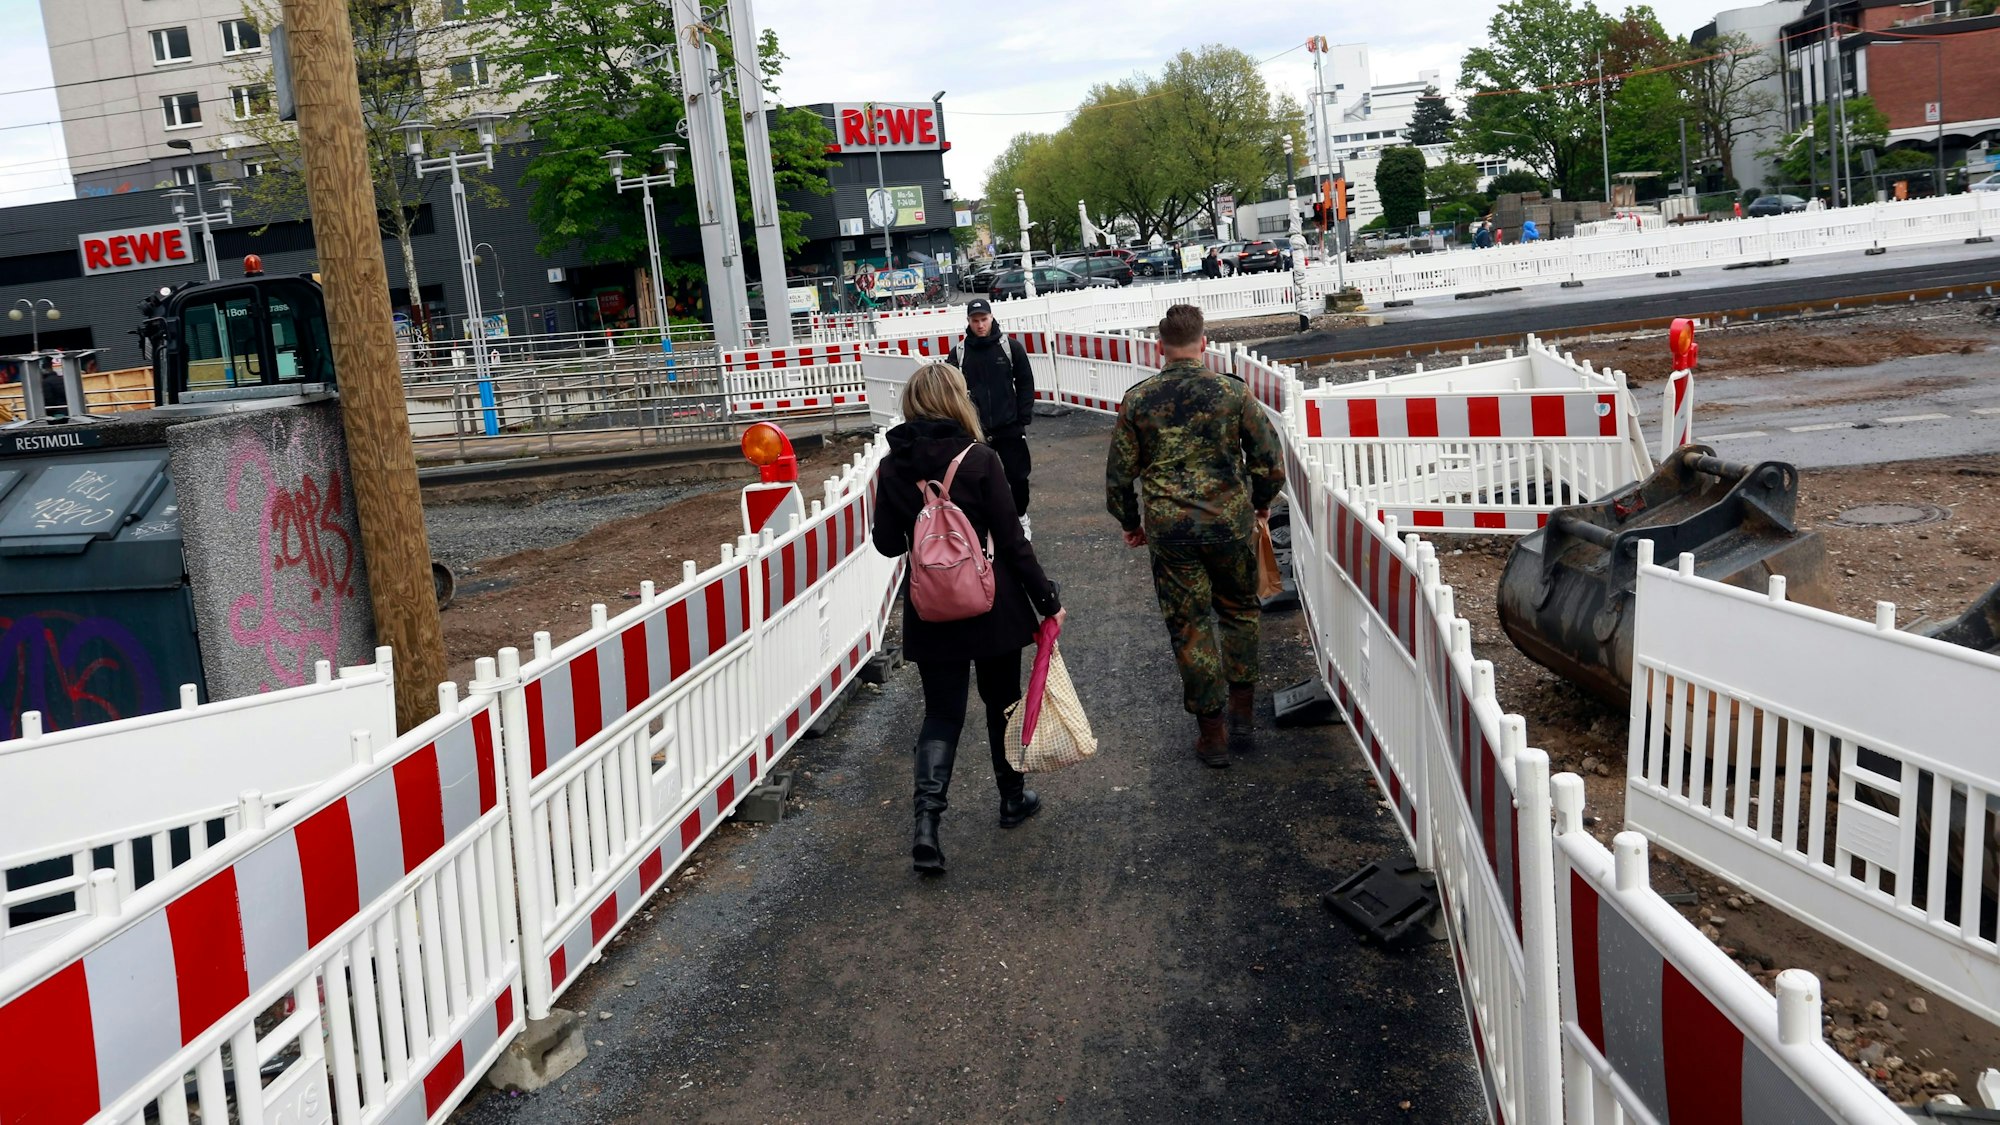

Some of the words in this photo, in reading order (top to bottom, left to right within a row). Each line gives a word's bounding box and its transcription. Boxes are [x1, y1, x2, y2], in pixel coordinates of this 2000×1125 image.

[842, 109, 937, 145] REWE
[84, 229, 186, 270] REWE
[15, 432, 84, 451] RESTMÜLL
